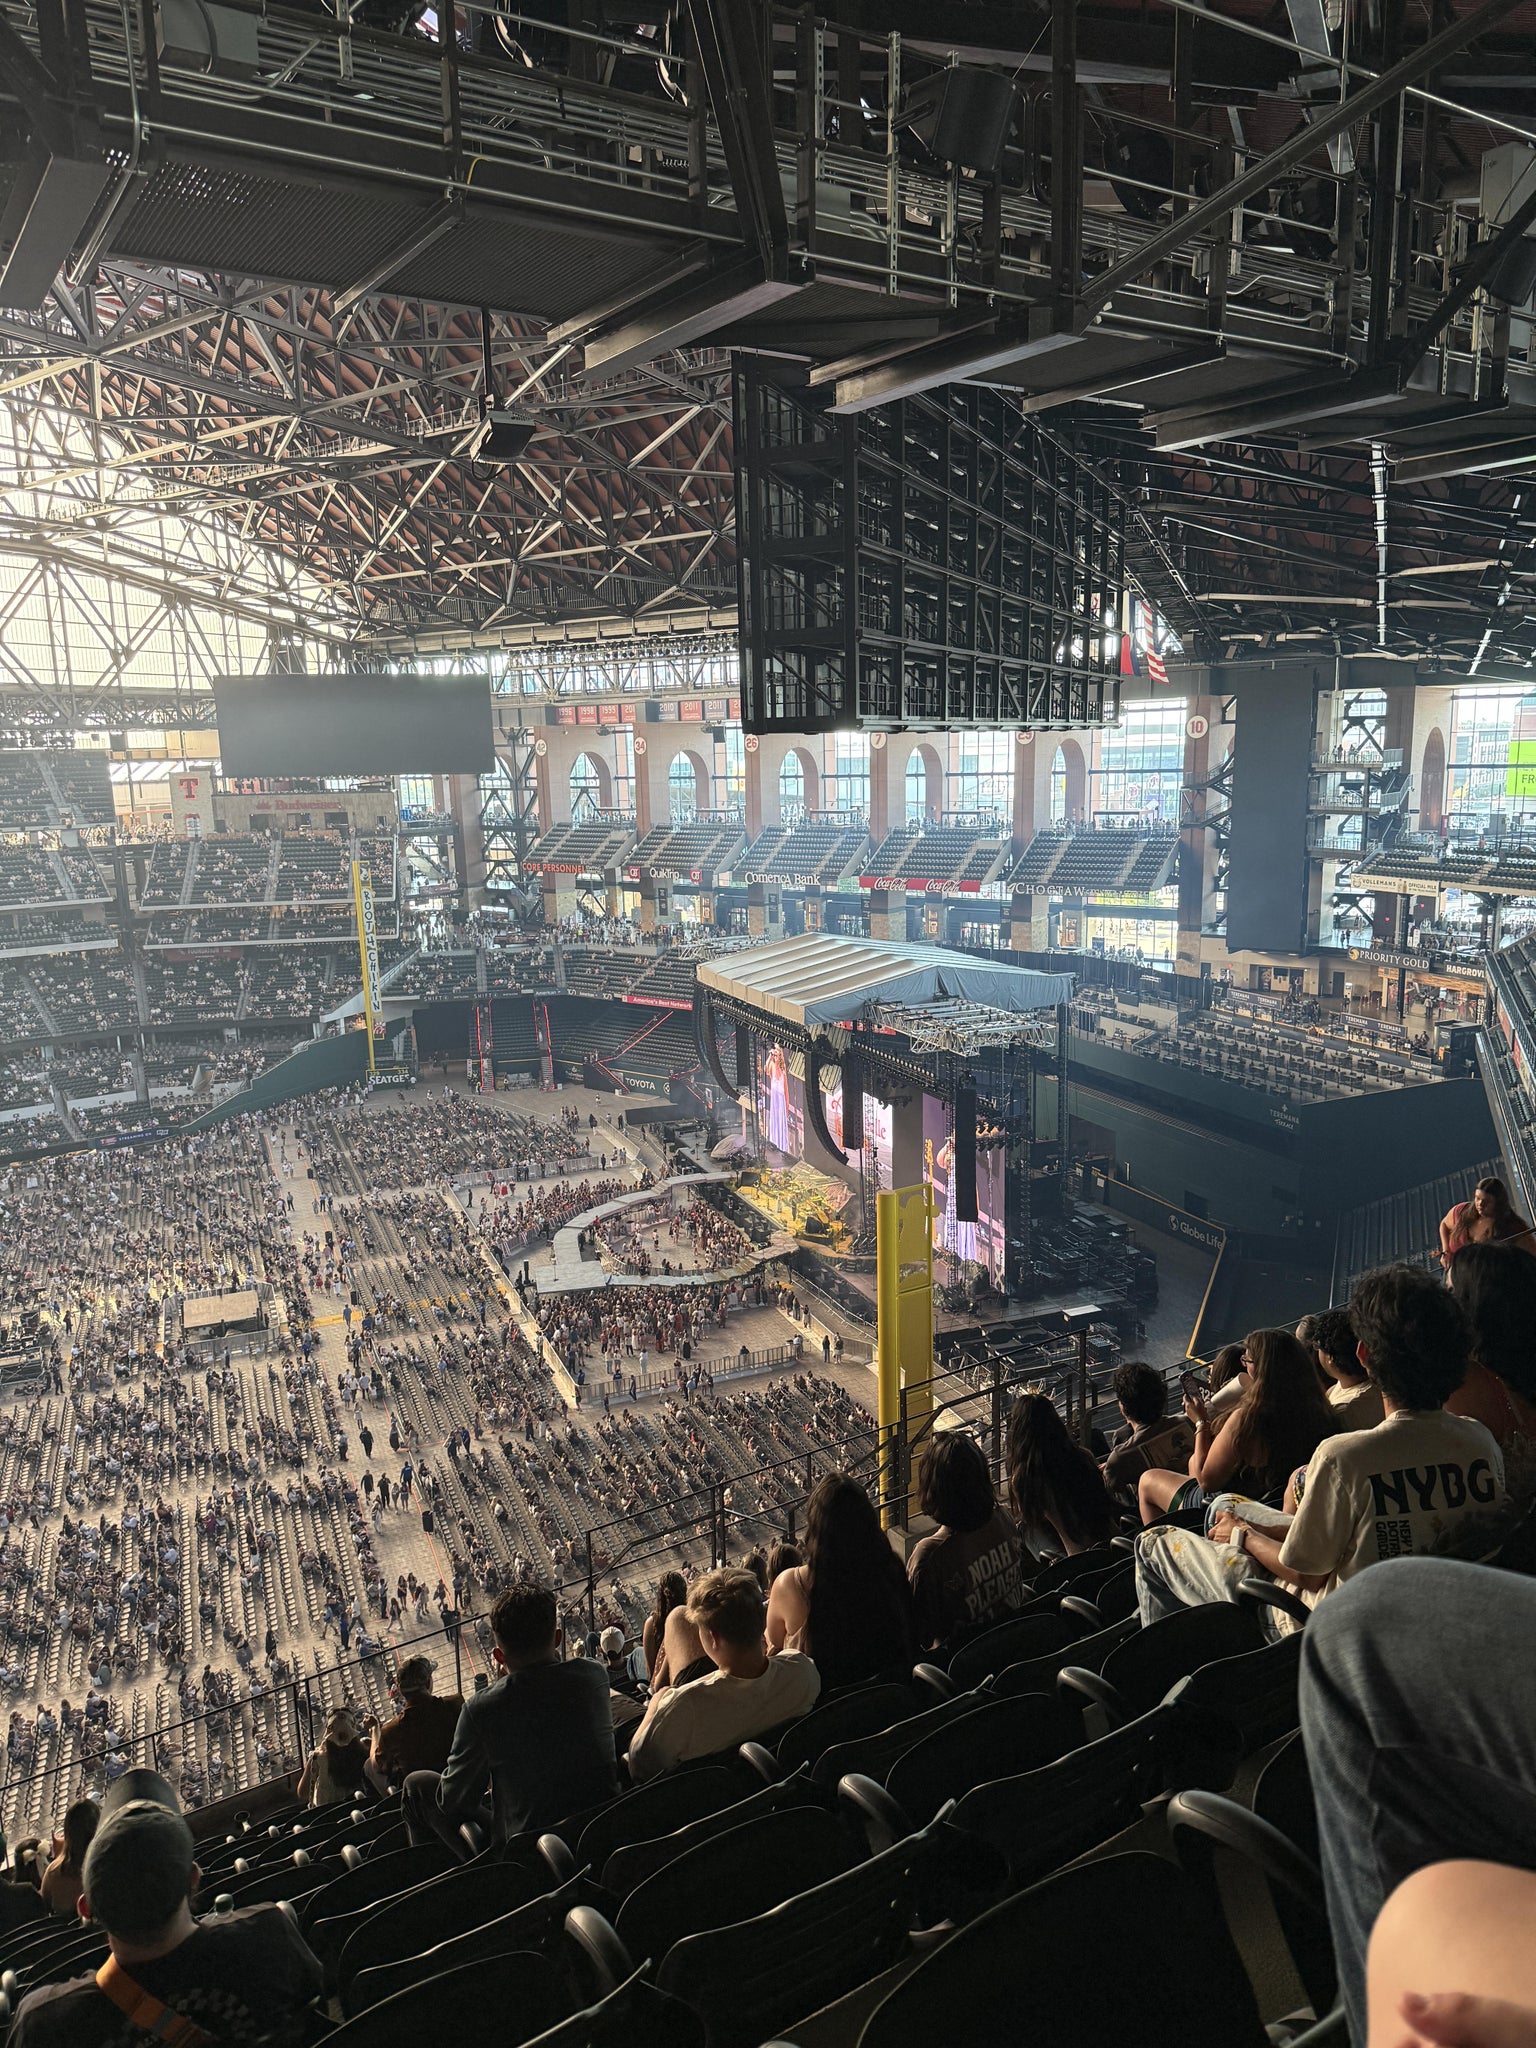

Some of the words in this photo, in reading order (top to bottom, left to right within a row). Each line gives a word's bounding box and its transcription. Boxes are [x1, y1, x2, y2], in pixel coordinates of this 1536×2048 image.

[624, 705, 636, 714] 201
[1191, 720, 1204, 733] 10
[635, 741, 645, 751] 34
[746, 738, 758, 748] 26
[1522, 774, 1536, 783] FR
[179, 777, 200, 800] T
[275, 799, 341, 810] Budweiser
[522, 862, 540, 872] CORE
[650, 867, 680, 880] QuikTrip
[794, 873, 820, 886] Bank
[1015, 882, 1085, 897] CHOCTAW
[364, 891, 373, 930] ROOT
[1360, 950, 1401, 965] PRIORITY
[1402, 957, 1429, 970] GOLD
[368, 952, 380, 1011] CHIKIN
[625, 1077, 656, 1090] TOYOTA
[119, 1133, 144, 1141] STREAMING
[1180, 1222, 1206, 1242] Globe
[1206, 1233, 1223, 1249] Life
[1368, 1459, 1496, 1516] NYBG
[1399, 1520, 1412, 1547] NEW
[967, 1541, 1012, 1590] NOAH
